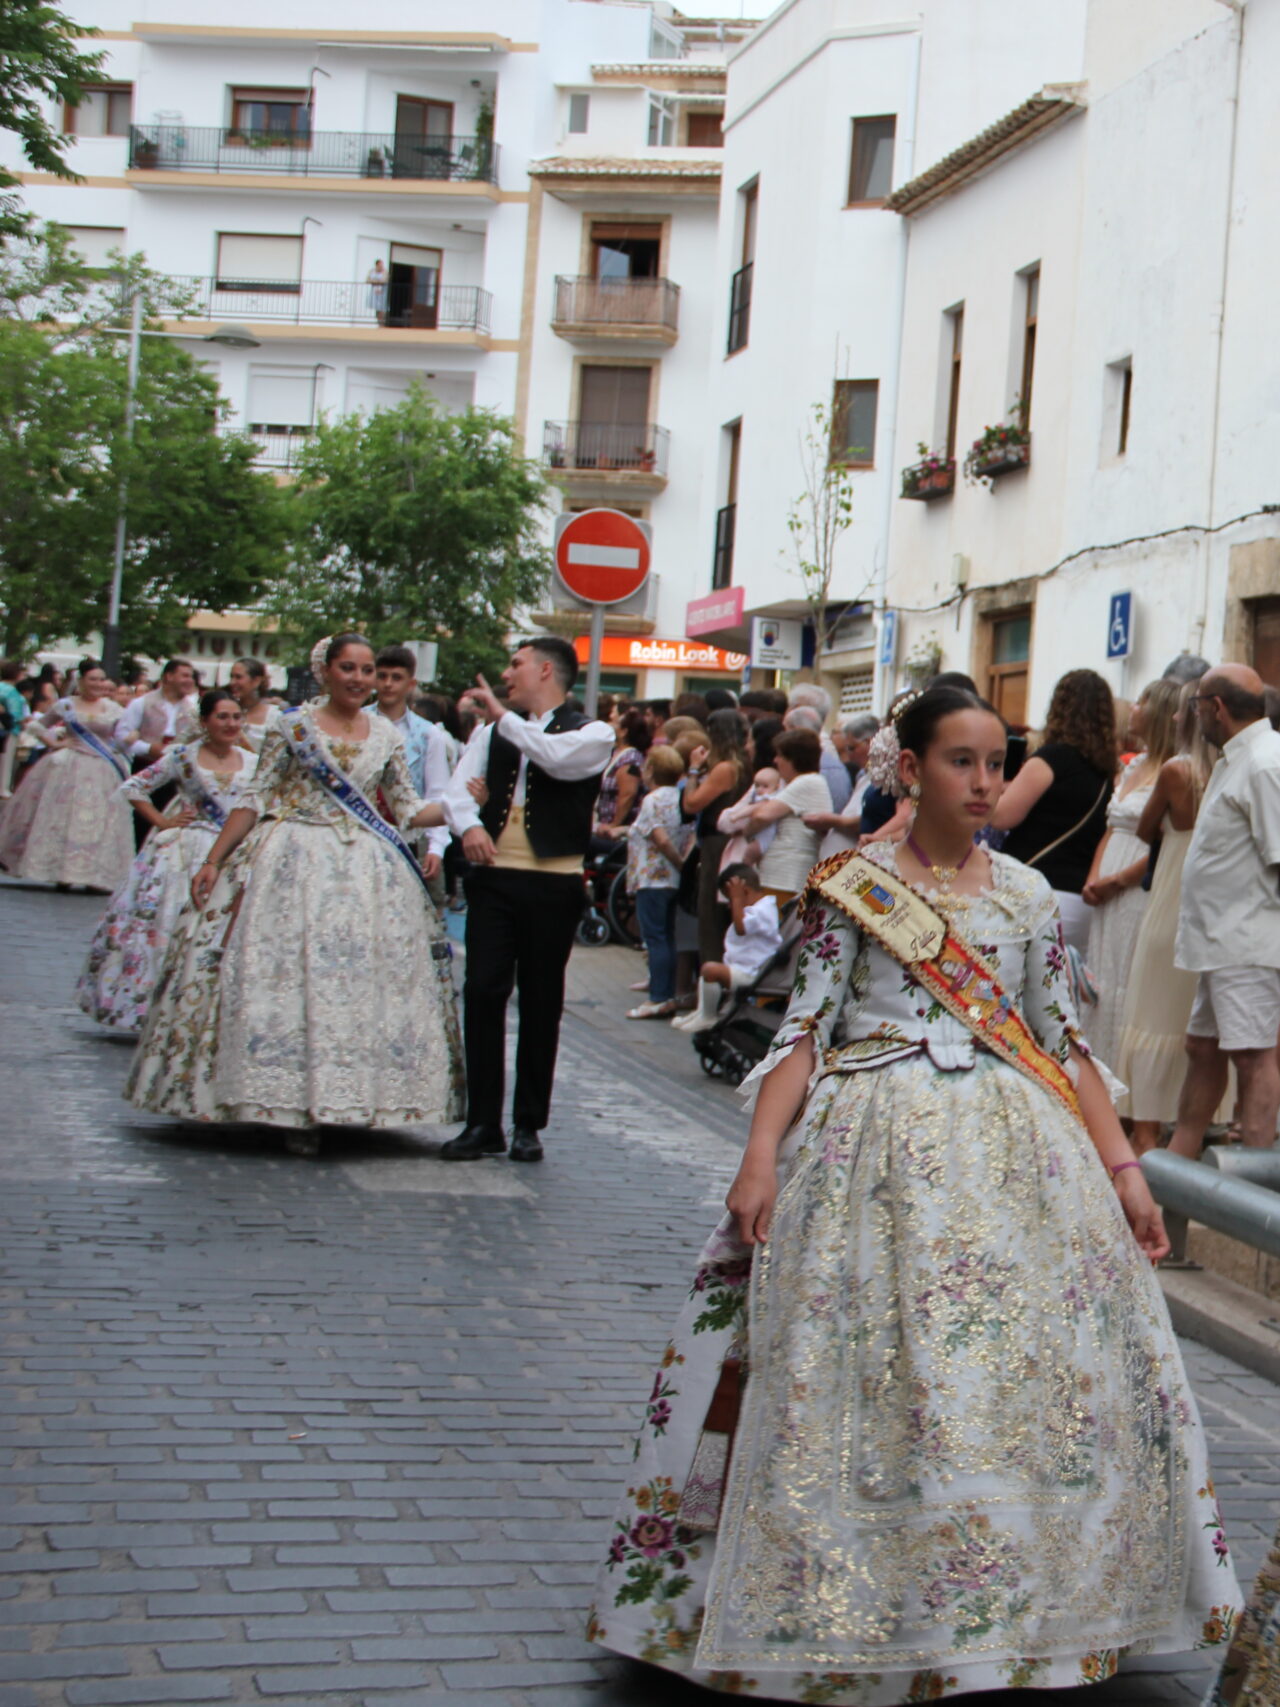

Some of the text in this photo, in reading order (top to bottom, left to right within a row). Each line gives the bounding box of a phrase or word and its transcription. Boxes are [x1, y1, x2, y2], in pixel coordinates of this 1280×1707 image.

[630, 640, 719, 662] Robin Look
[840, 868, 867, 891] 2023
